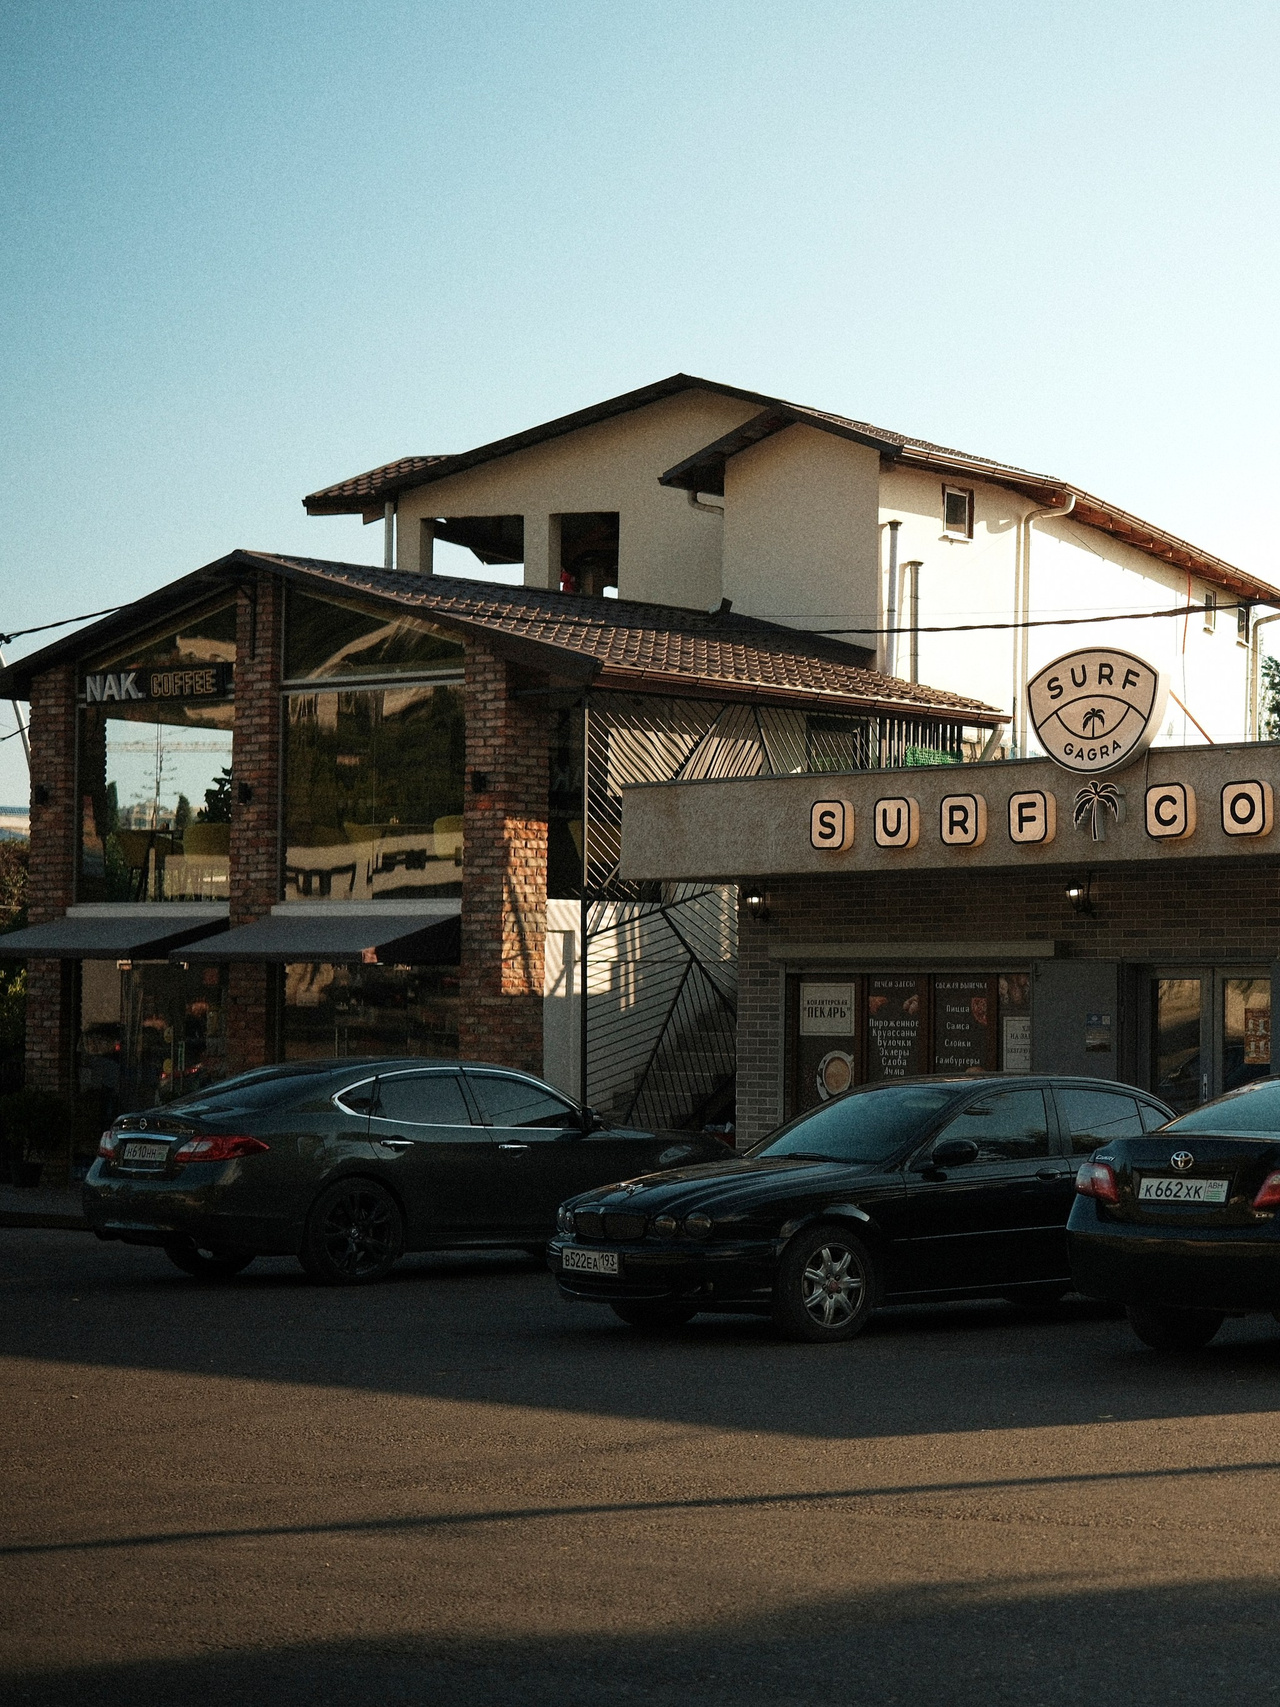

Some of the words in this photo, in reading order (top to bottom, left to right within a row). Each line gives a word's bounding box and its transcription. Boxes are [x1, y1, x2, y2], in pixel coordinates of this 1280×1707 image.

[150, 669, 217, 698] COFFEE
[1047, 662, 1140, 700] SURF
[1063, 739, 1122, 762] GAGRA
[816, 799, 1040, 841] SURF
[803, 1006, 851, 1018] "ПЕКАРЬ"
[946, 1004, 970, 1014] Пицца
[946, 1021, 970, 1030] Самса
[872, 1028, 917, 1039] Круассаны
[877, 1036, 912, 1048] Булочки
[944, 1038, 971, 1047] Слойки
[879, 1047, 910, 1058] Эклеры
[881, 1056, 907, 1066] Сдоба
[935, 1055, 980, 1066] Гамбургеры
[883, 1066, 905, 1076] Ачма
[600, 1253, 615, 1267] 193
